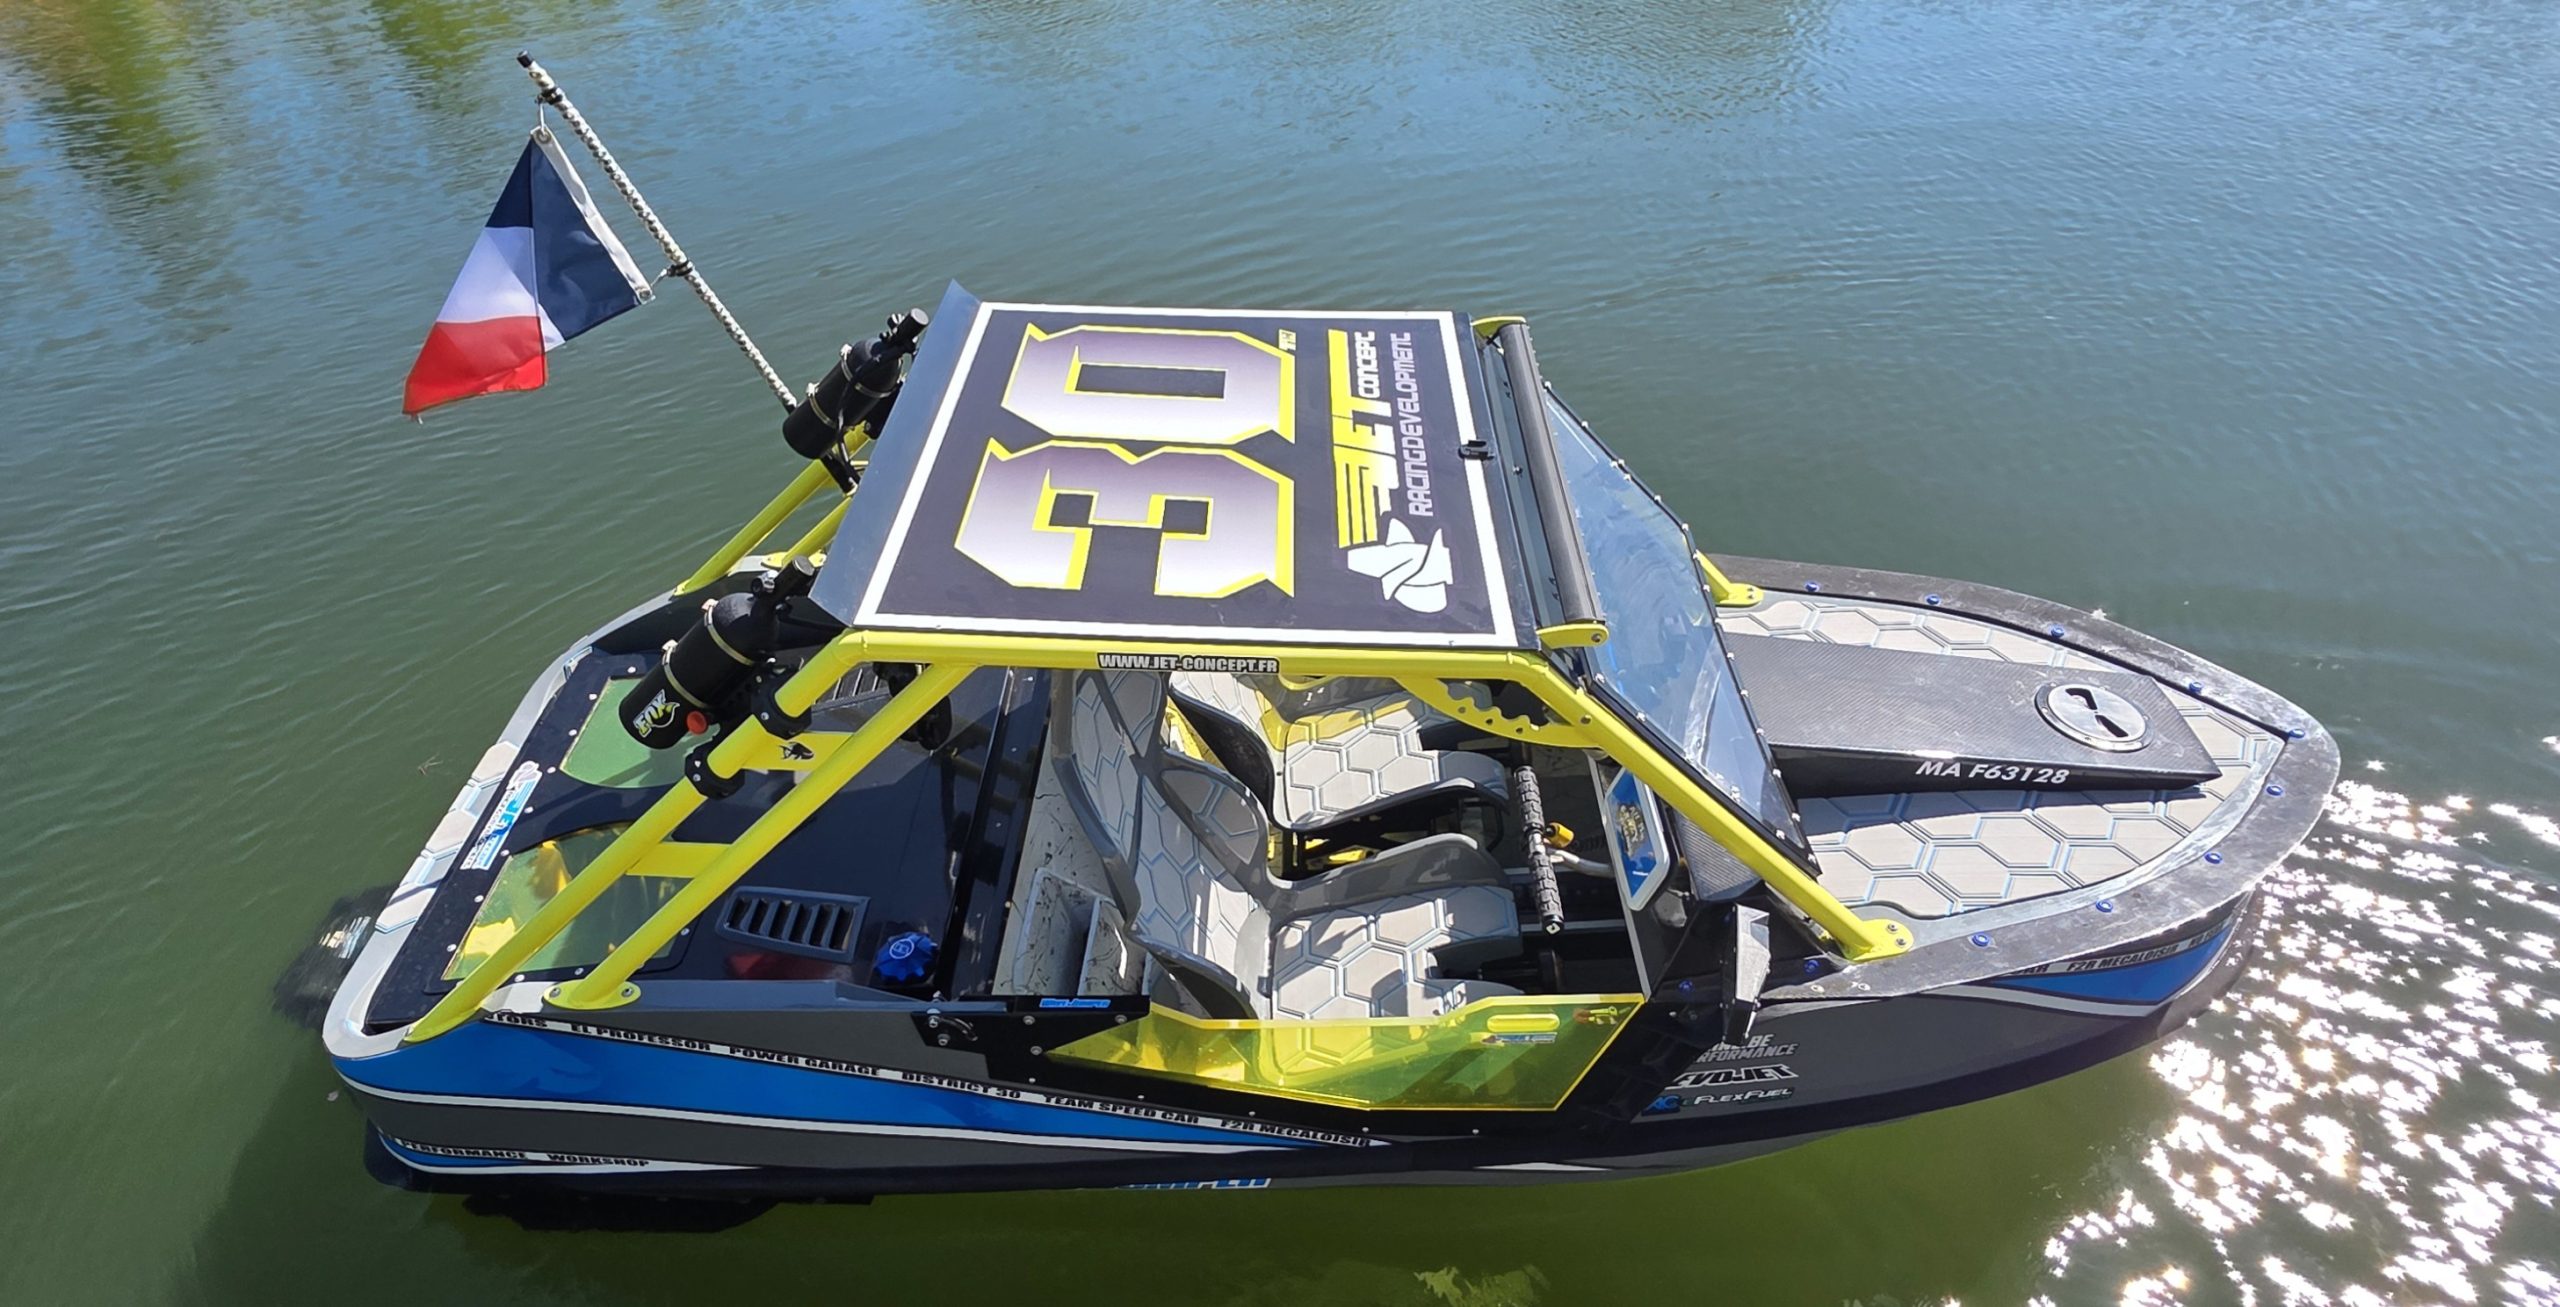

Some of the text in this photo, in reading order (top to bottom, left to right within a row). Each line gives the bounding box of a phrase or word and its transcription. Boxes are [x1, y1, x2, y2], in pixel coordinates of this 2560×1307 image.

[1354, 330, 1380, 399] CONCEPT
[955, 323, 1296, 598] 30
[1327, 329, 1399, 549] JET
[1099, 654, 1278, 673] WWW.JET-CONCEPT.FR
[633, 689, 680, 737] FOX
[1915, 760, 2070, 784] MA F63128
[571, 1022, 592, 1034] EL
[597, 1026, 712, 1050] PROFESSOR
[729, 1046, 800, 1065] POWER
[804, 1057, 881, 1077] GARAGE
[901, 1071, 993, 1093] DISTRICT
[995, 1086, 1021, 1099] 30
[1043, 1095, 1095, 1110] TEAM
[1097, 1102, 1156, 1117] SPEED
[1160, 1109, 1200, 1124] CAR
[1220, 1118, 1255, 1132] F2R
[547, 1152, 650, 1168] WORKSHOP
